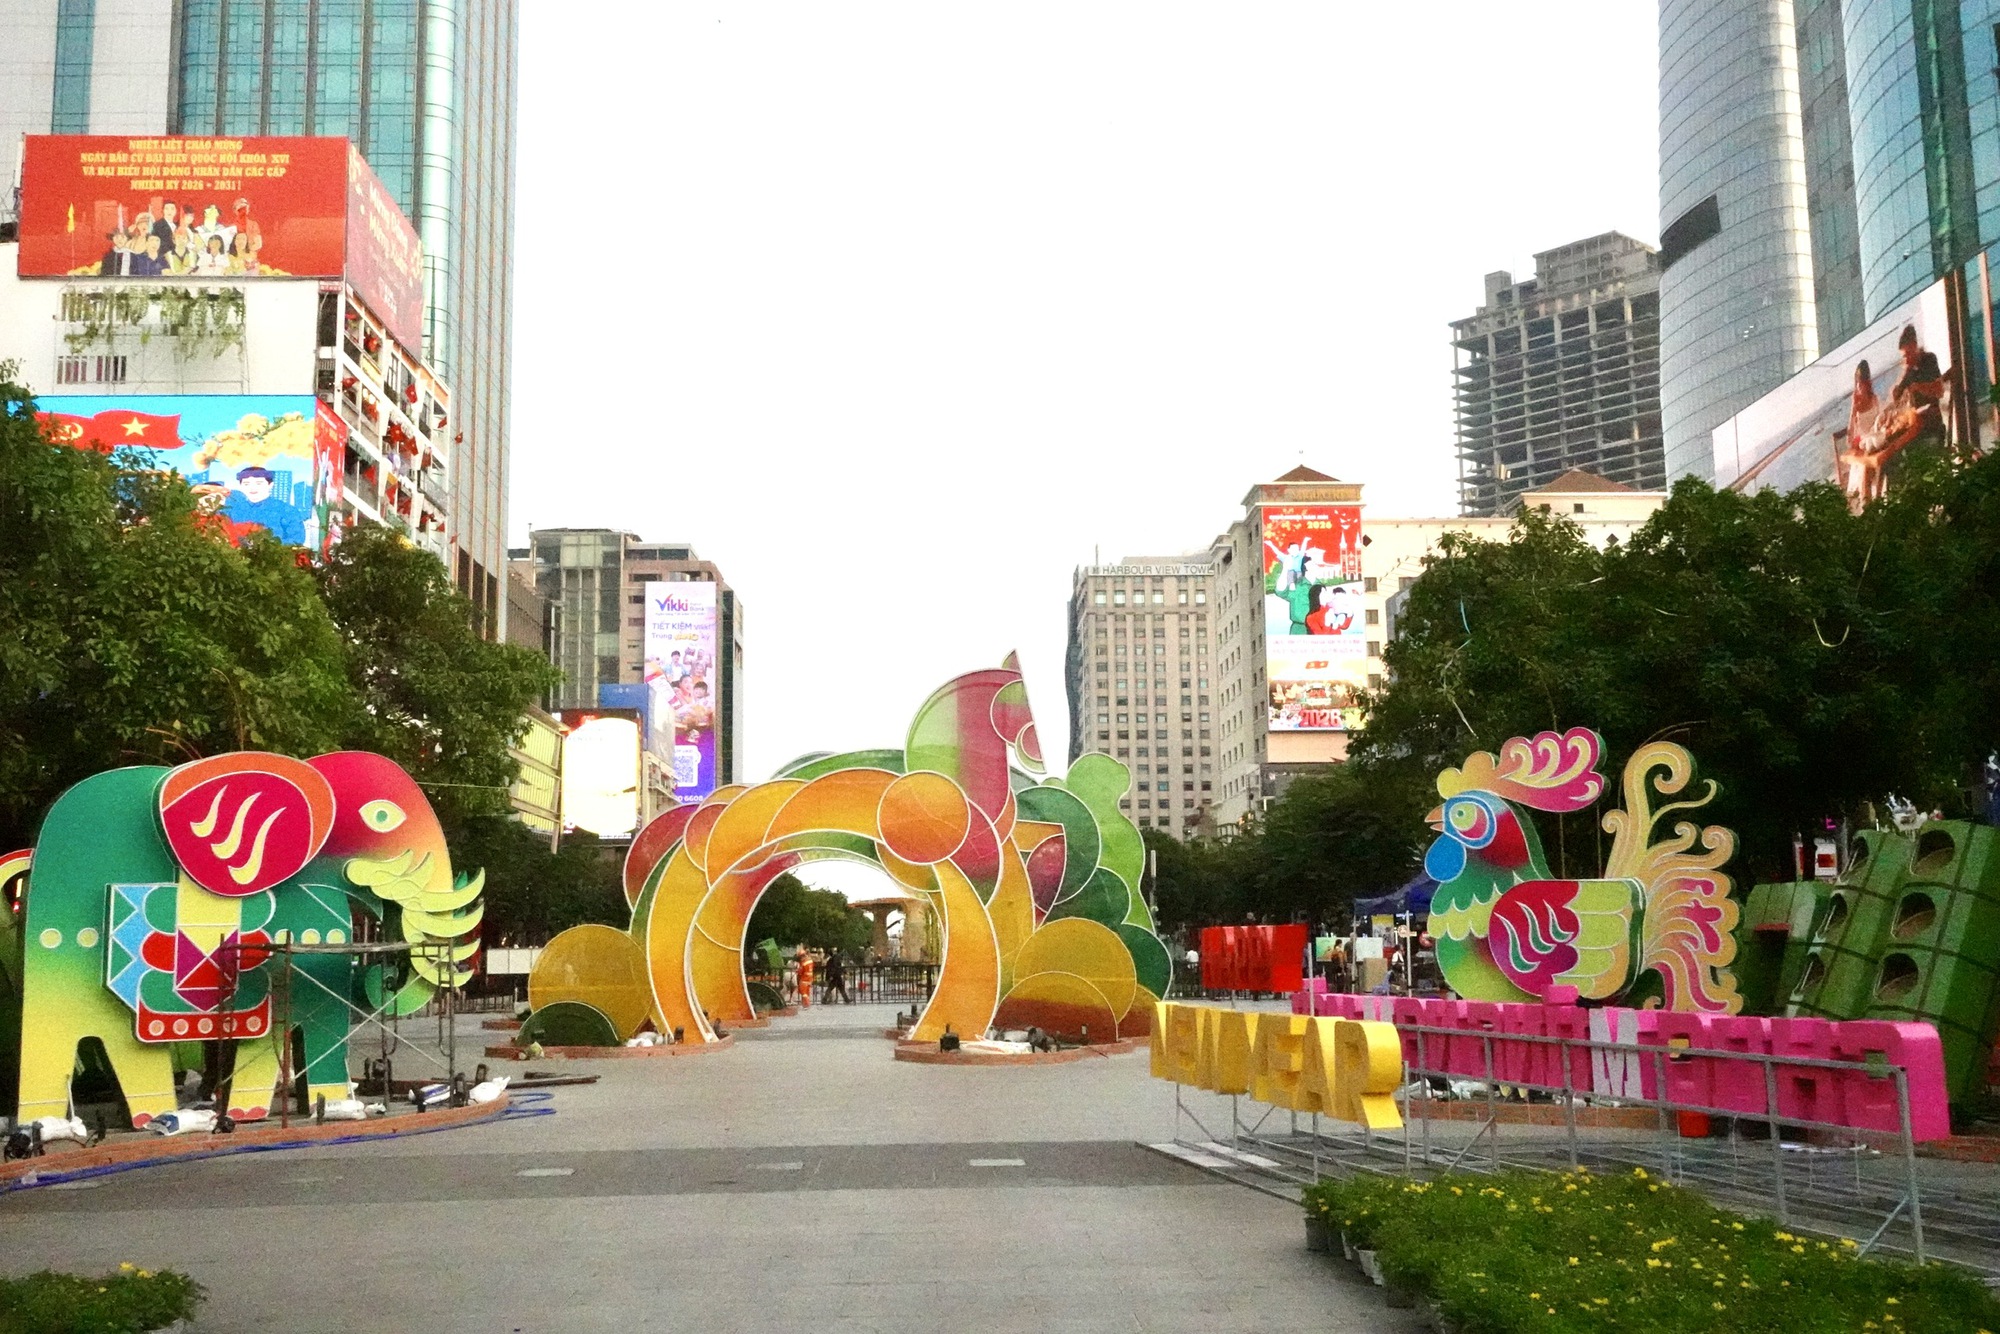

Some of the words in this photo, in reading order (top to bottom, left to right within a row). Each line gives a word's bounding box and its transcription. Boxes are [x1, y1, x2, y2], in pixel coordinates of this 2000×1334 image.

[271, 154, 290, 164] XVI
[182, 180, 204, 190] 2026
[1306, 521, 1332, 529] 2026
[1102, 566, 1152, 574] HARBOUR
[1156, 566, 1180, 574] VIEW
[655, 594, 688, 612] Vikki
[672, 620, 692, 631] KIỆM
[1298, 709, 1342, 728] 2026
[1150, 1001, 1249, 1095] NEW
[1244, 1010, 1404, 1129] YEAR
